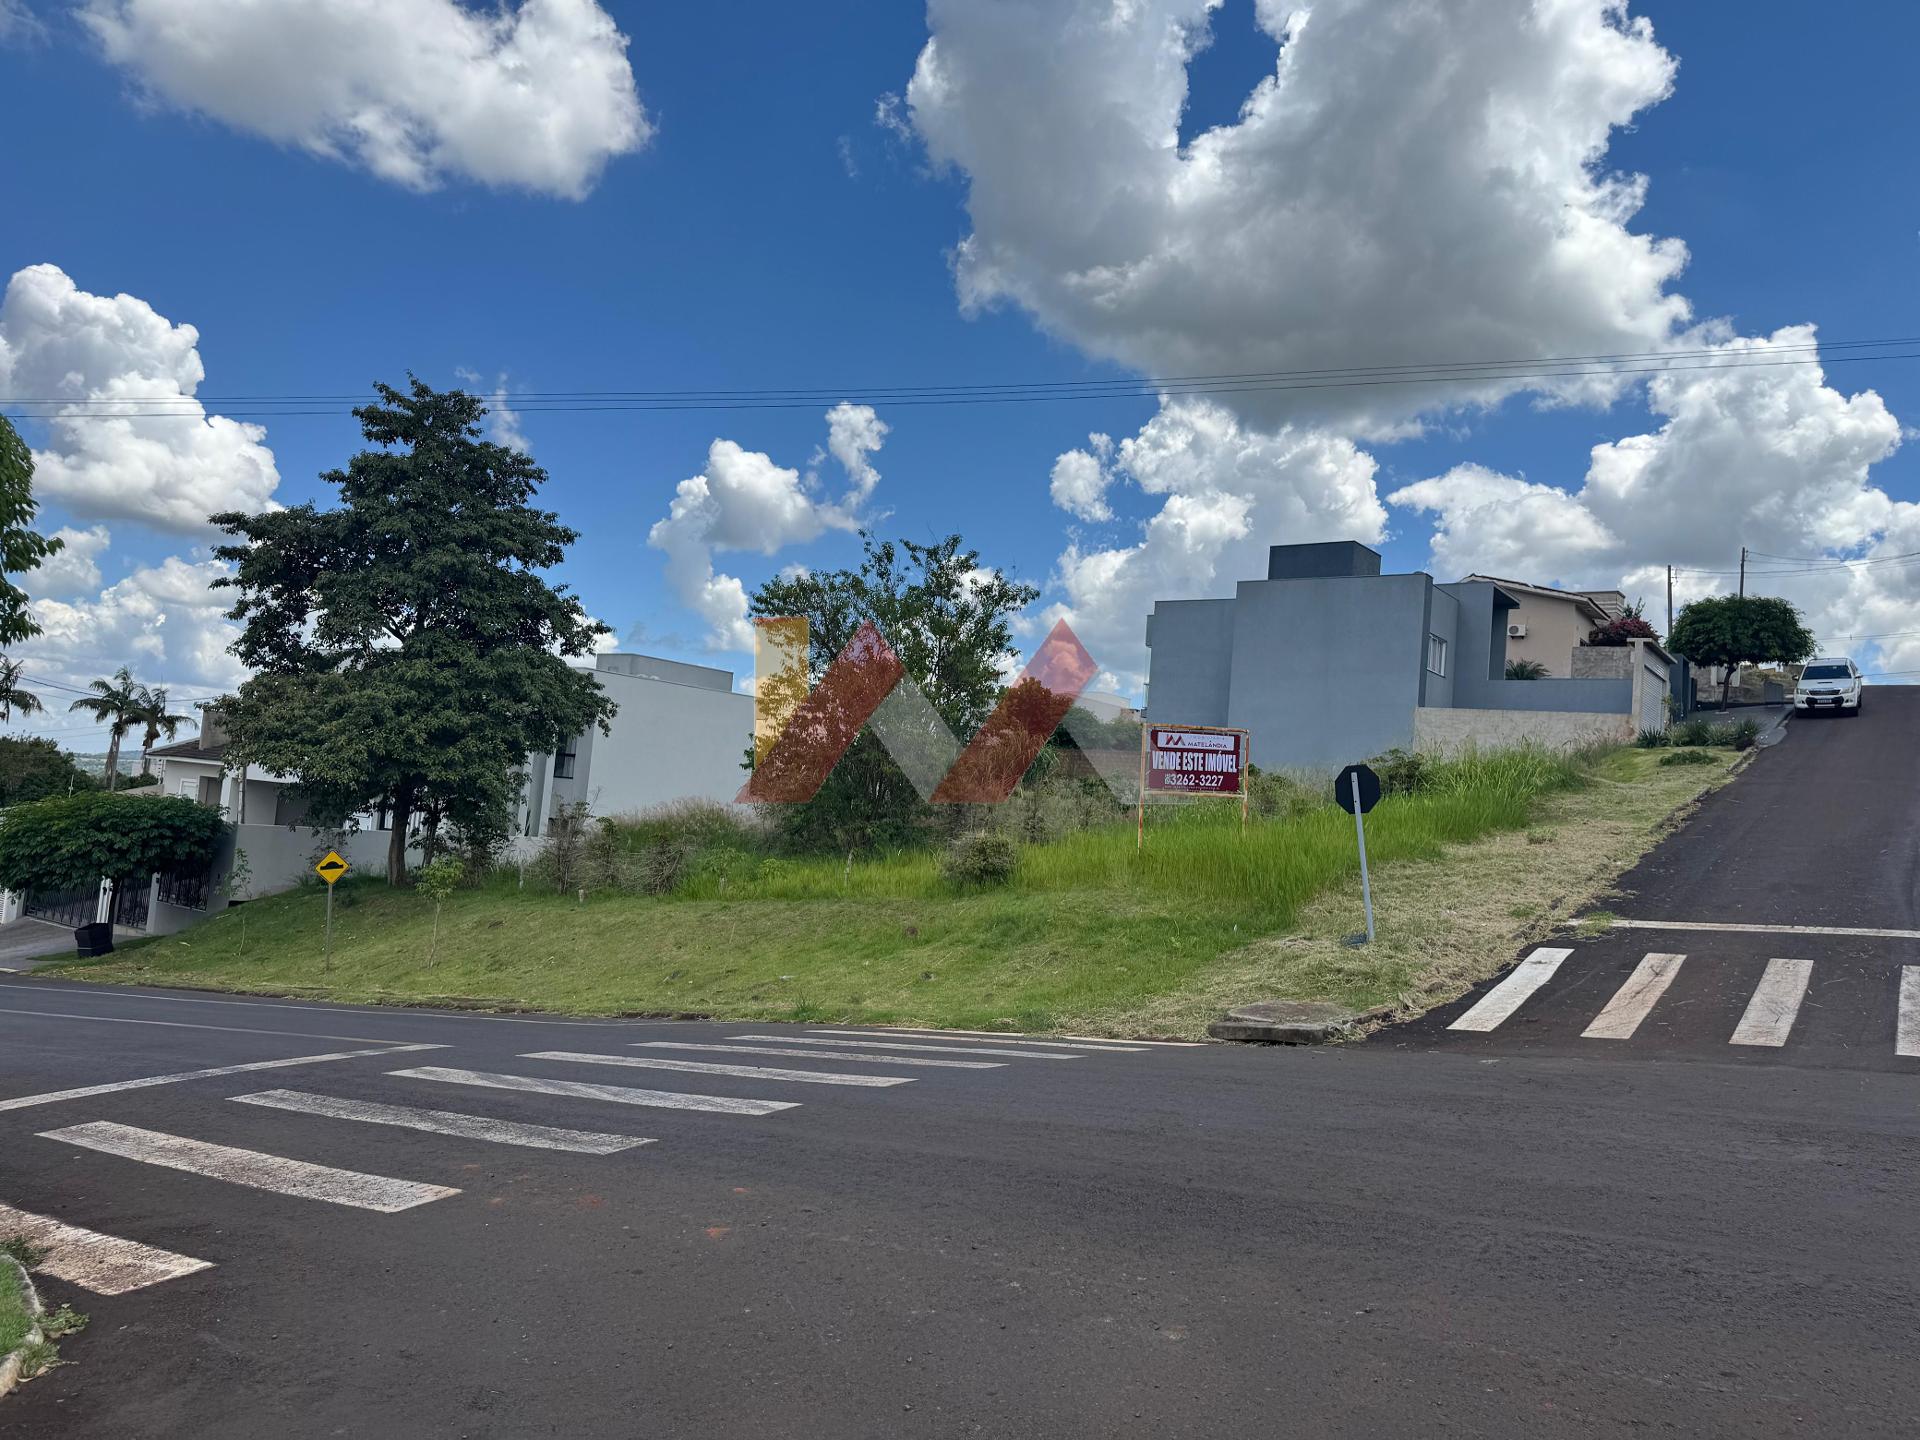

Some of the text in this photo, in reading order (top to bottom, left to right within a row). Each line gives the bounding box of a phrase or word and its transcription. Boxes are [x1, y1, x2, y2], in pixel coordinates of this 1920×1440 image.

[1152, 751, 1237, 773] VENDE ESTE IMÓVEL
[1171, 774, 1223, 786] 3262-3227
